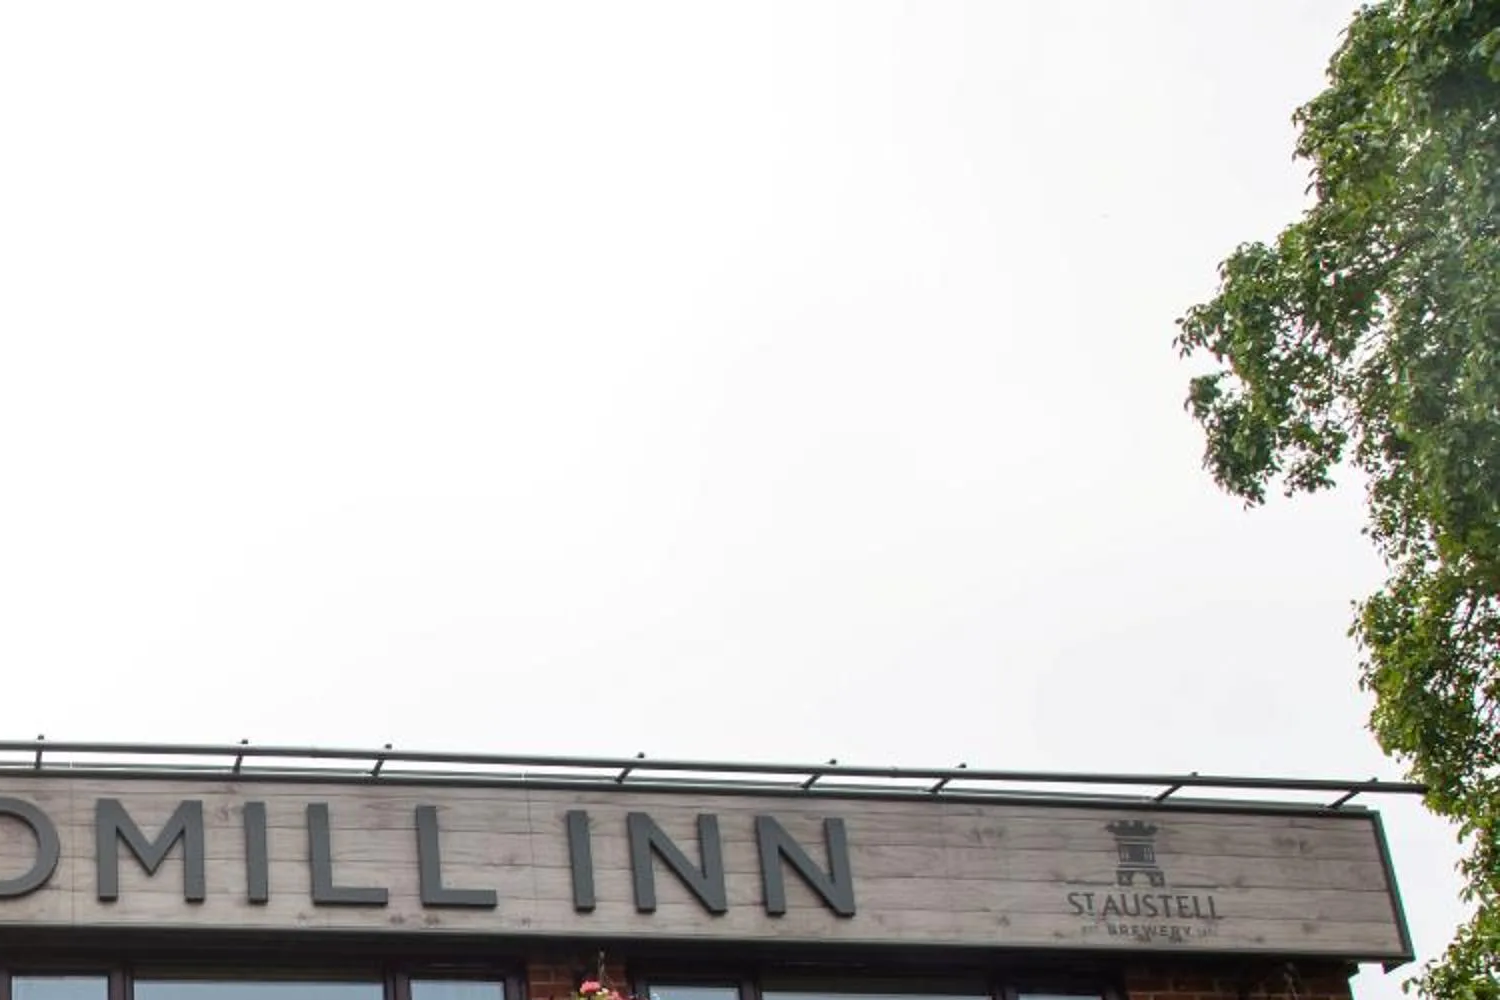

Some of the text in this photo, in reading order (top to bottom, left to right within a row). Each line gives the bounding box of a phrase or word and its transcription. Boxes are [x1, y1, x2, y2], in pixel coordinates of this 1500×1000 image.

[566, 809, 856, 917] INN
[1102, 893, 1224, 920] AUSTELL
[1108, 924, 1191, 938] BREWERY
